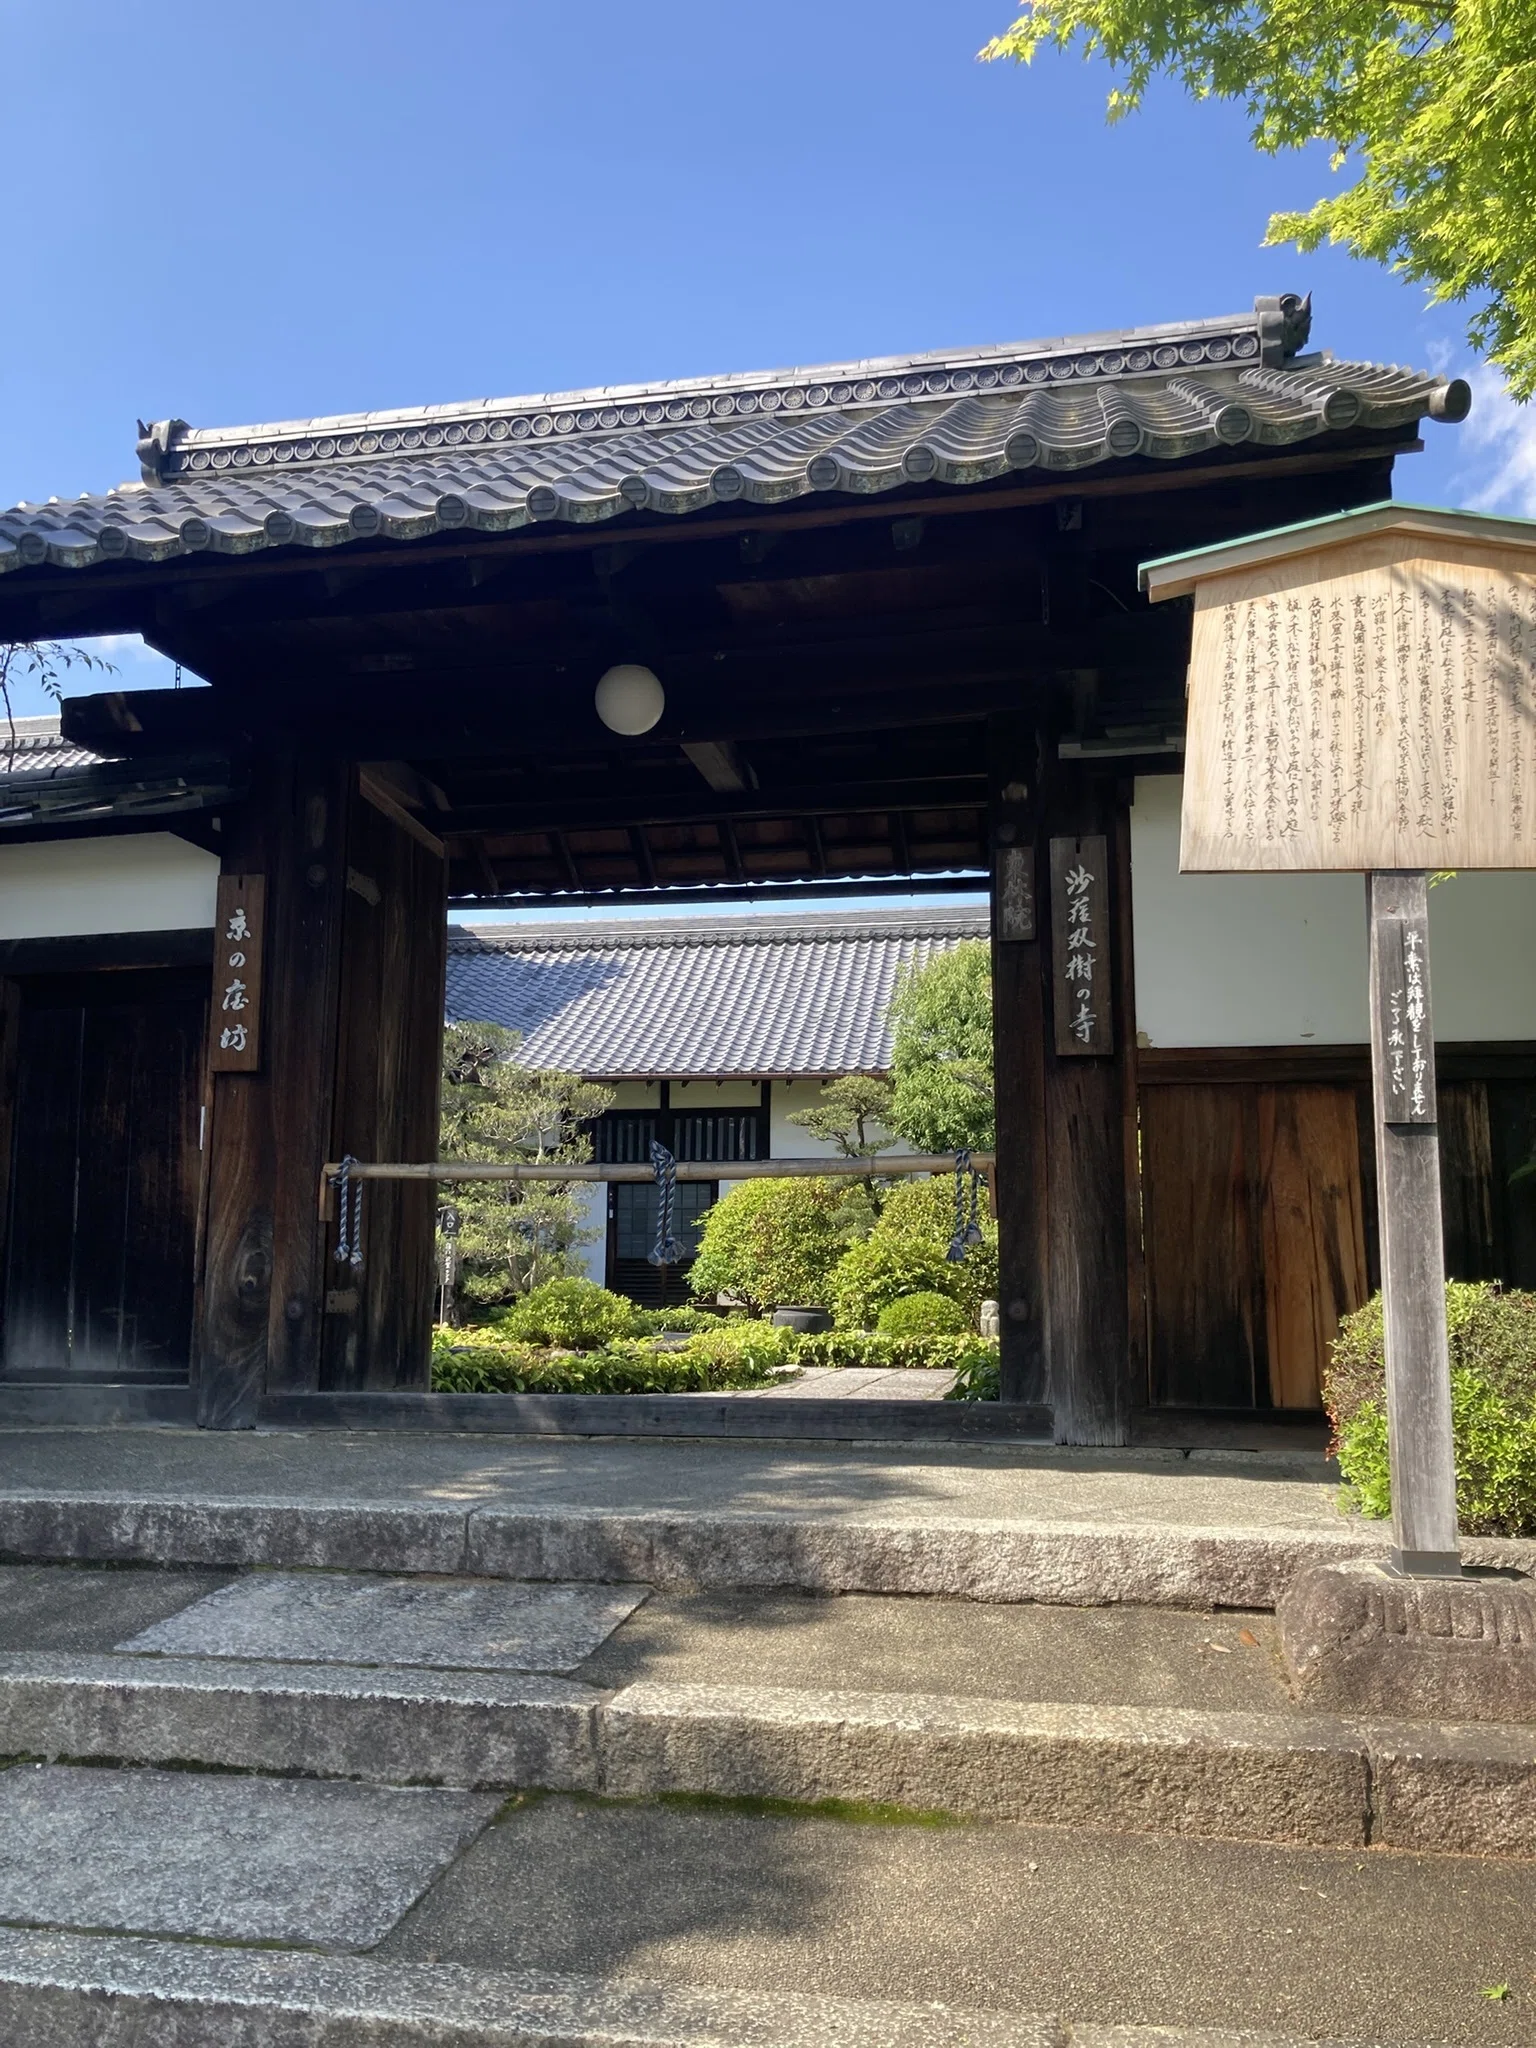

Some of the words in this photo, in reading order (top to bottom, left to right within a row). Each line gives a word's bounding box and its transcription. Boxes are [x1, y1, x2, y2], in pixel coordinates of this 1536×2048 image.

[1003, 849, 1033, 934] 東林院
[1064, 864, 1097, 1043] 沙羅双樹の寺
[1388, 989, 1406, 1095] ご了承下さい
[446, 1211, 456, 1228] 入口
